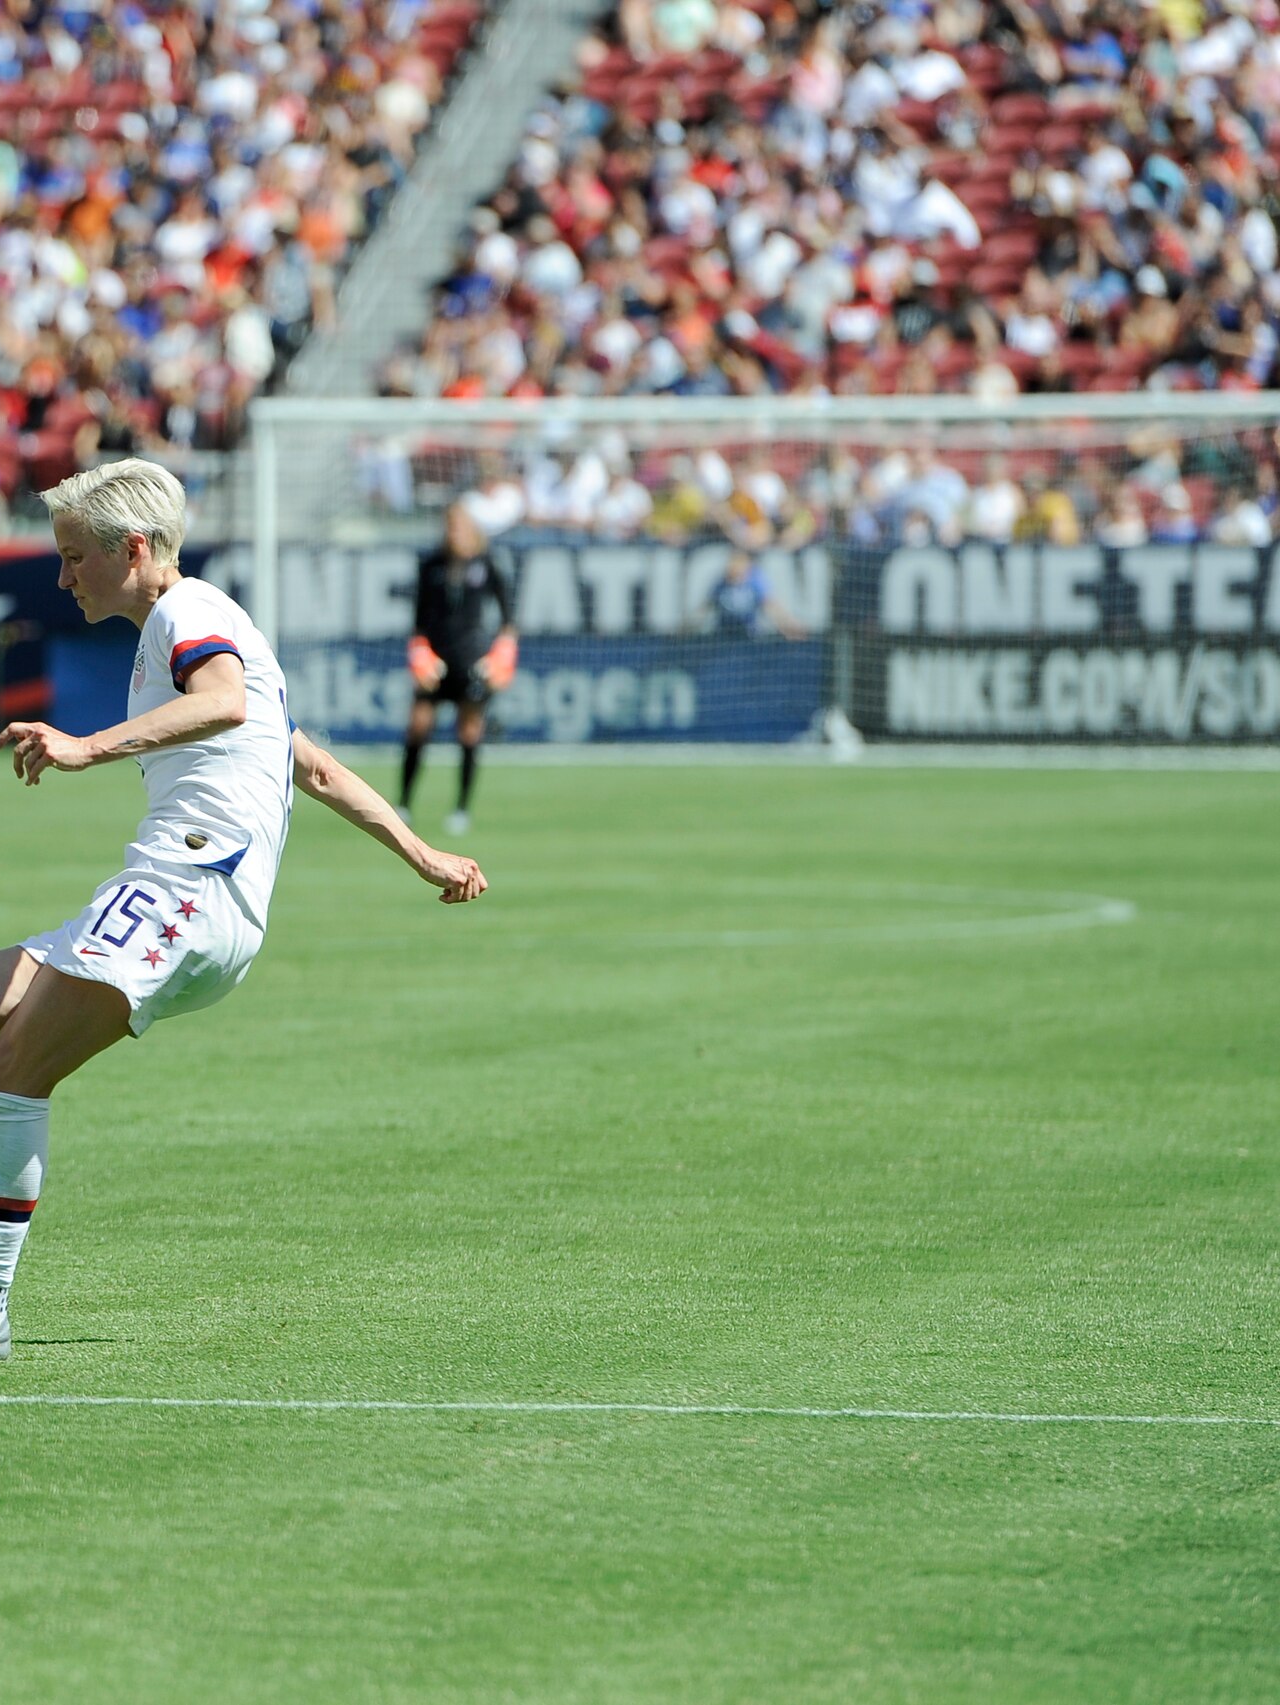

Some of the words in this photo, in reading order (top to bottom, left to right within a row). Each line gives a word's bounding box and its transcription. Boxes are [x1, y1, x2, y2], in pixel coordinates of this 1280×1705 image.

[880, 545, 1103, 635] ONE
[1121, 545, 1280, 635] TE
[90, 884, 157, 949] 15
